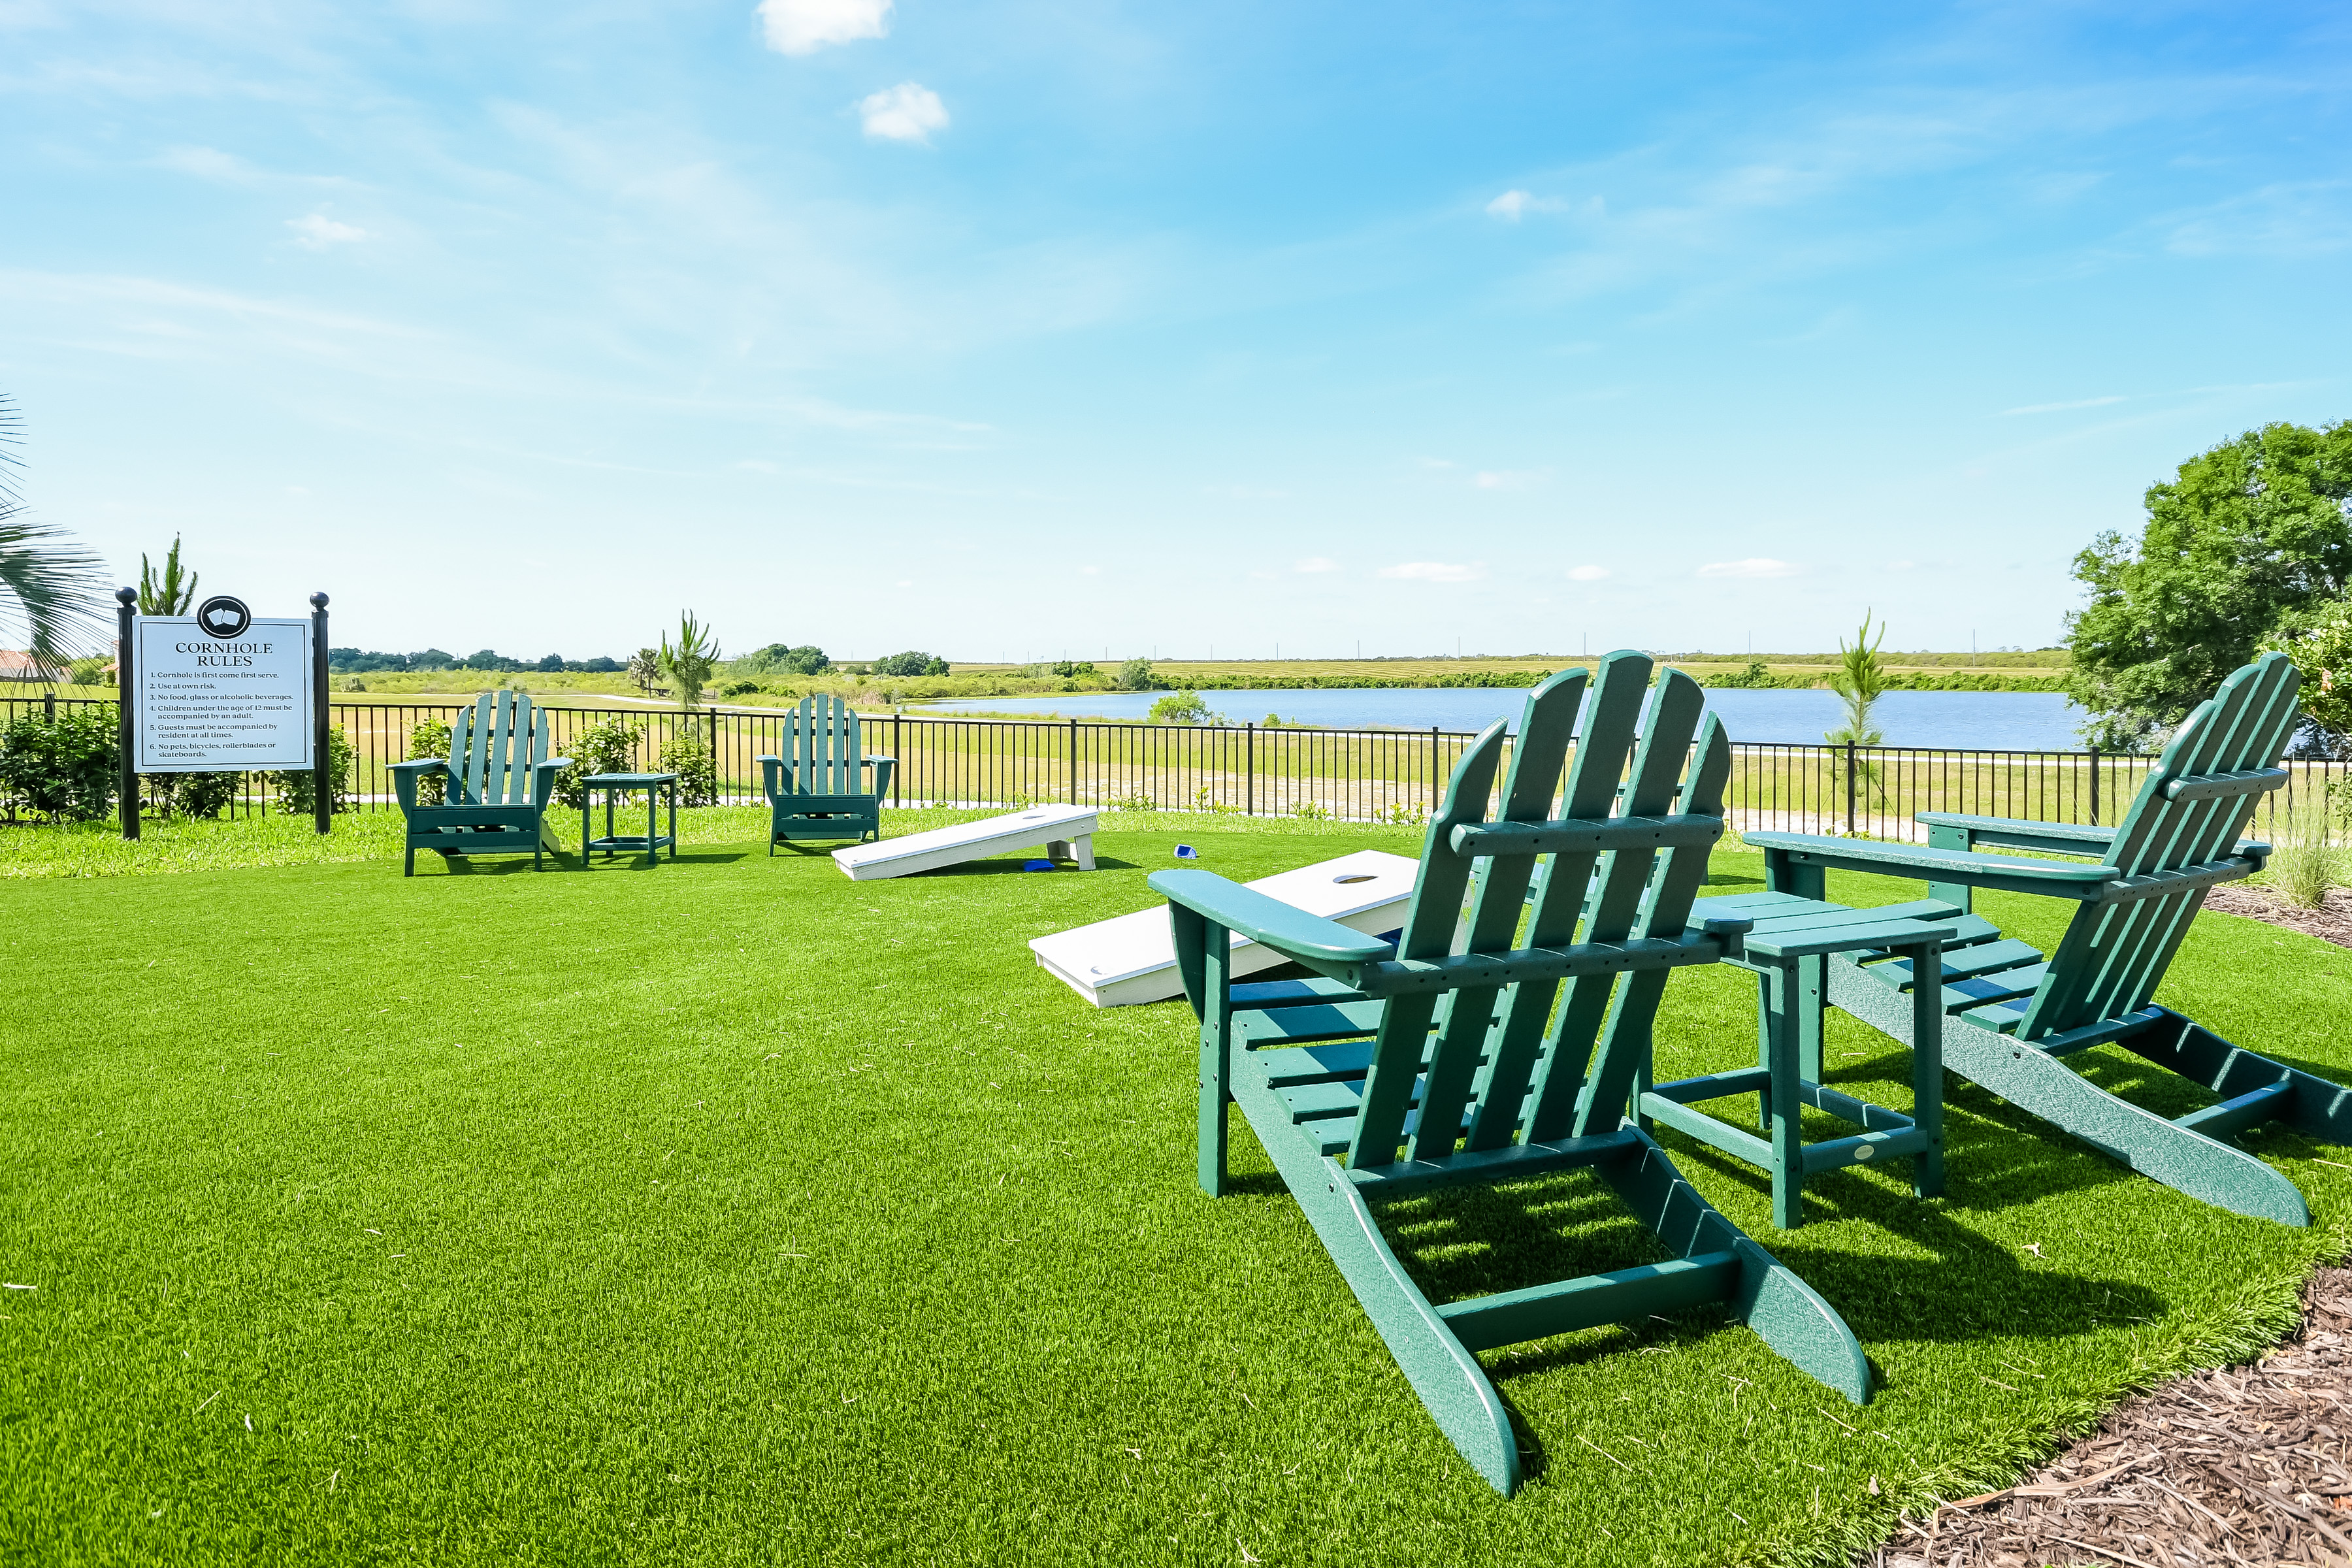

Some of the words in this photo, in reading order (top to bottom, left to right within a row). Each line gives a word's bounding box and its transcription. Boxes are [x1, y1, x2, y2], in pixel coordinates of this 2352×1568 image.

[175, 642, 273, 654] CORNHOLE
[196, 655, 253, 666] RULES
[157, 712, 210, 721] accompanied
